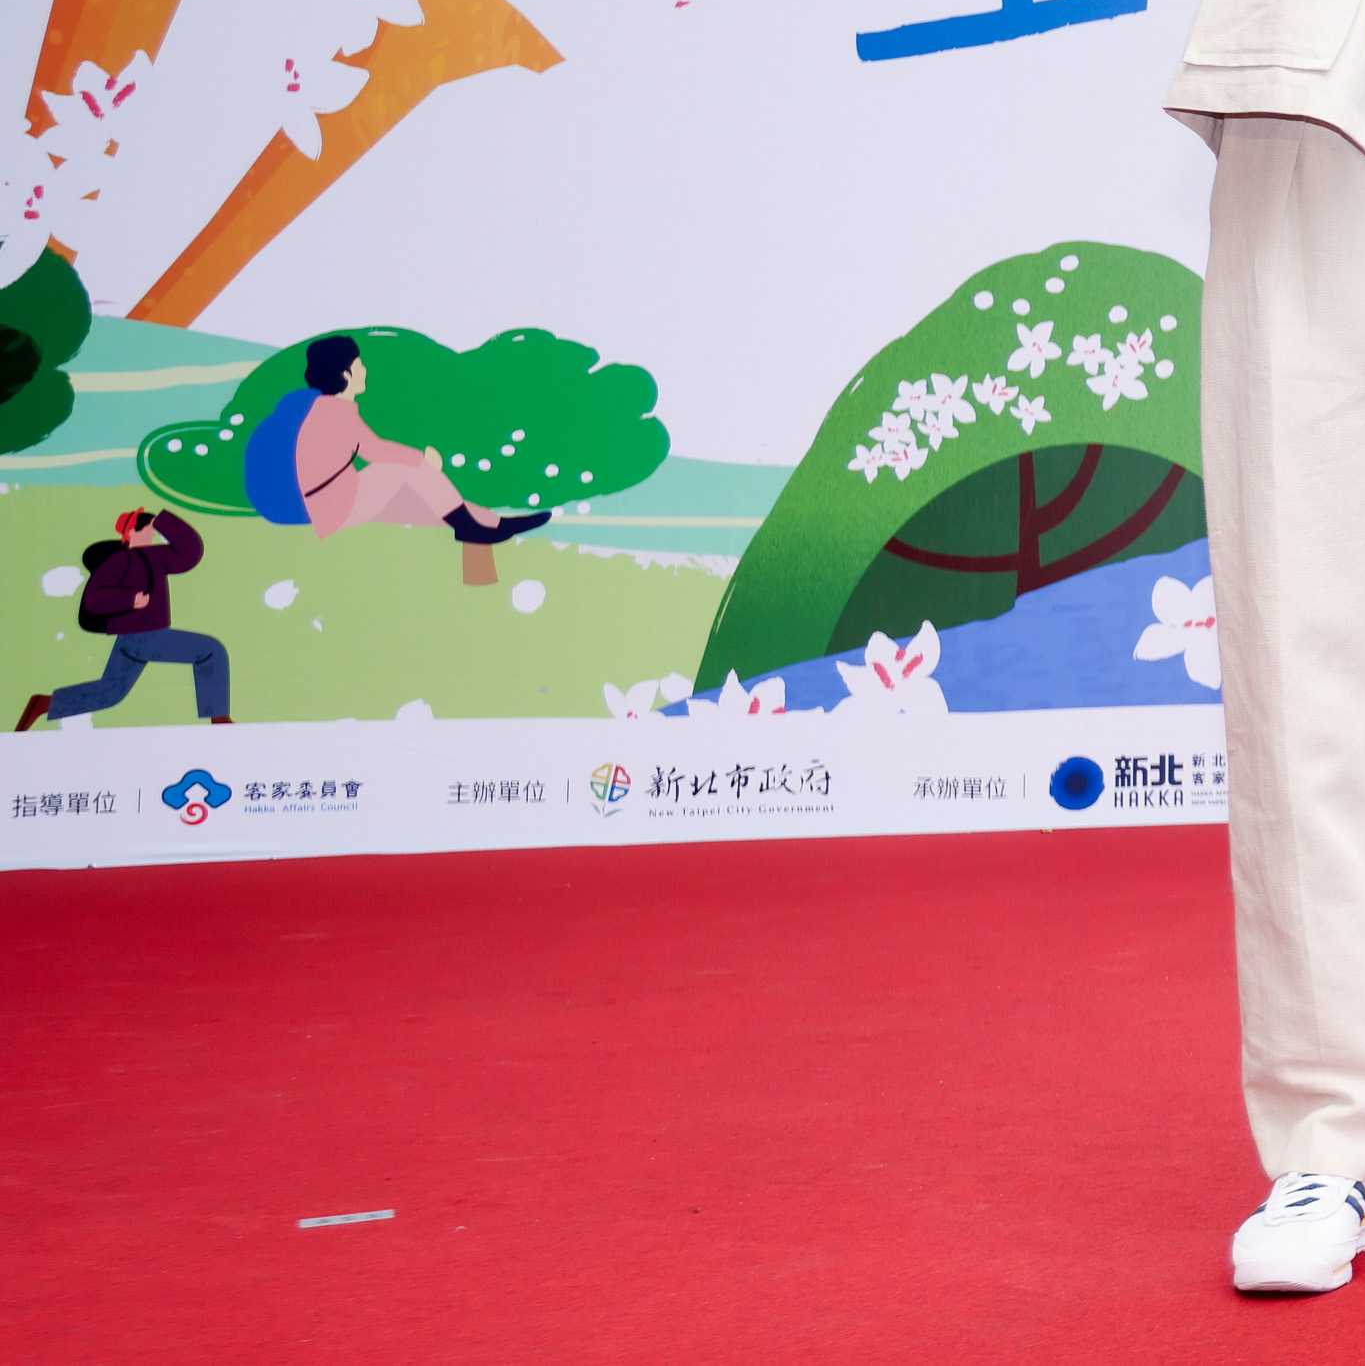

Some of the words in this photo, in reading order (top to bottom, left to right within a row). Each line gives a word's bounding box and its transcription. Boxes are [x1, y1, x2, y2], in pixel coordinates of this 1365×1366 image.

[645, 758, 831, 803] 新北市政府
[1114, 754, 1184, 787] 新北
[243, 779, 364, 801] 客家委員會
[447, 778, 546, 805] 主辦單位
[913, 776, 1008, 801] 承辦單位
[1114, 789, 1184, 808] HAKKA
[12, 790, 117, 819] 指導單位
[244, 803, 276, 814] Hakka
[282, 802, 316, 813] Affairs
[320, 801, 359, 813] Council
[648, 807, 675, 818] New
[681, 806, 721, 819] Taipei
[726, 804, 753, 818] City
[758, 803, 836, 815] Government
